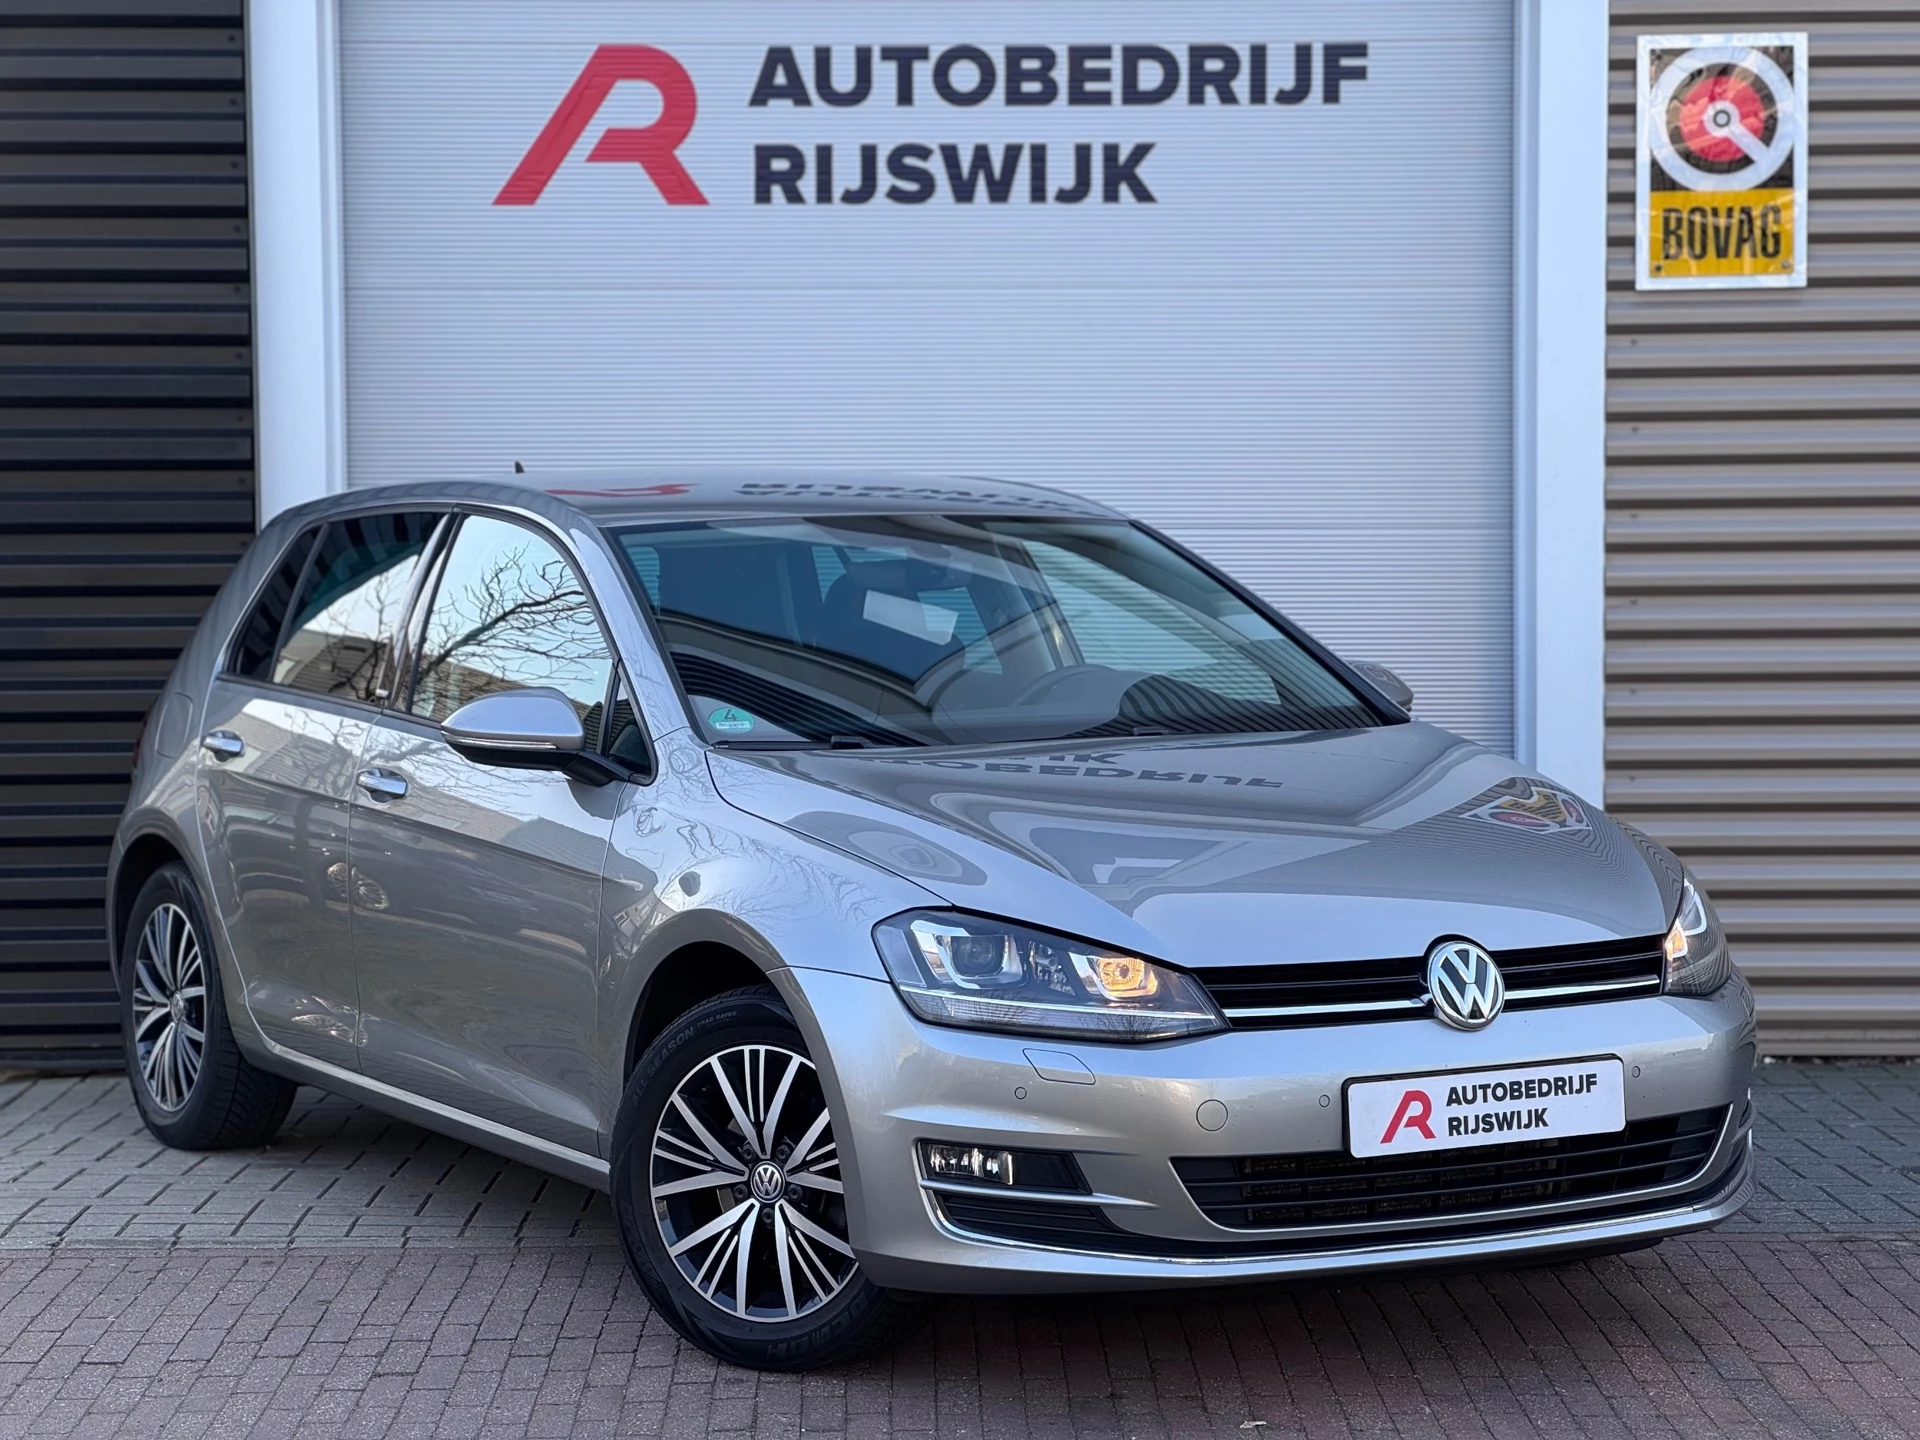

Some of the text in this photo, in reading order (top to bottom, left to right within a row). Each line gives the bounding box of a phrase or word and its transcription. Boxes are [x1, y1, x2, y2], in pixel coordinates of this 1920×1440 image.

[748, 41, 1369, 108] AUTOBEDRIJF
[752, 141, 1159, 206] RIJSWIJK
[1662, 204, 1781, 260] BOVAG
[631, 1026, 695, 1107] ALL SEASON
[1446, 1073, 1598, 1107] AUTOBEDRIJF
[1447, 1108, 1549, 1137] RIJSWIJK
